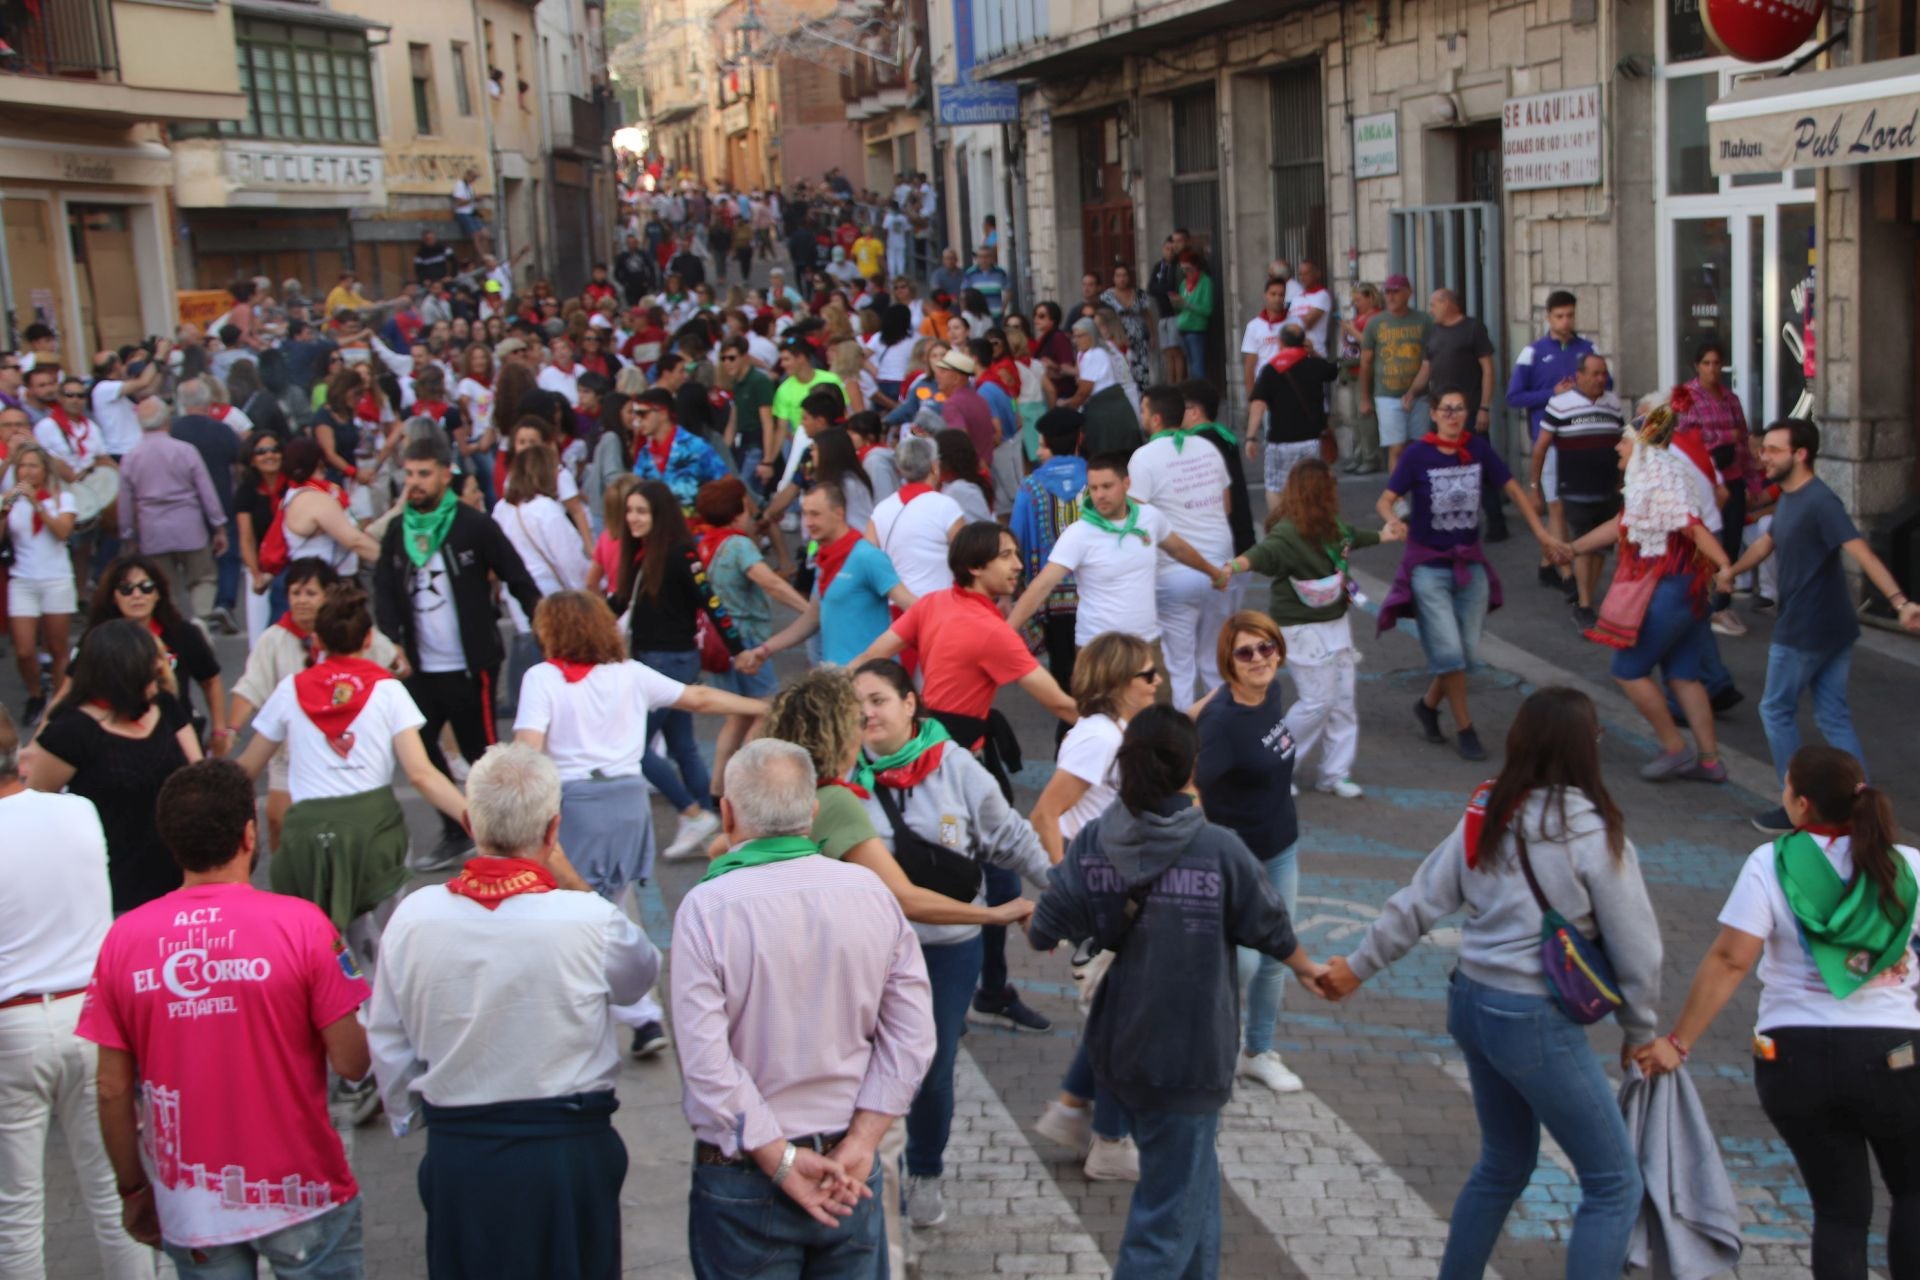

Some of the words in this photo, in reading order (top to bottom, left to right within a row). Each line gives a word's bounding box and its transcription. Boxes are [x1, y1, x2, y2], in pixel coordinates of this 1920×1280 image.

[1504, 104, 1520, 129] SE
[1526, 92, 1595, 126] ALQUILAN
[1504, 138, 1532, 155] LOCALES
[1720, 138, 1762, 159] Mahou
[1793, 112, 1843, 161] Pub
[1848, 108, 1919, 155] Lord
[132, 968, 161, 994] EL
[162, 948, 271, 998] CORRO
